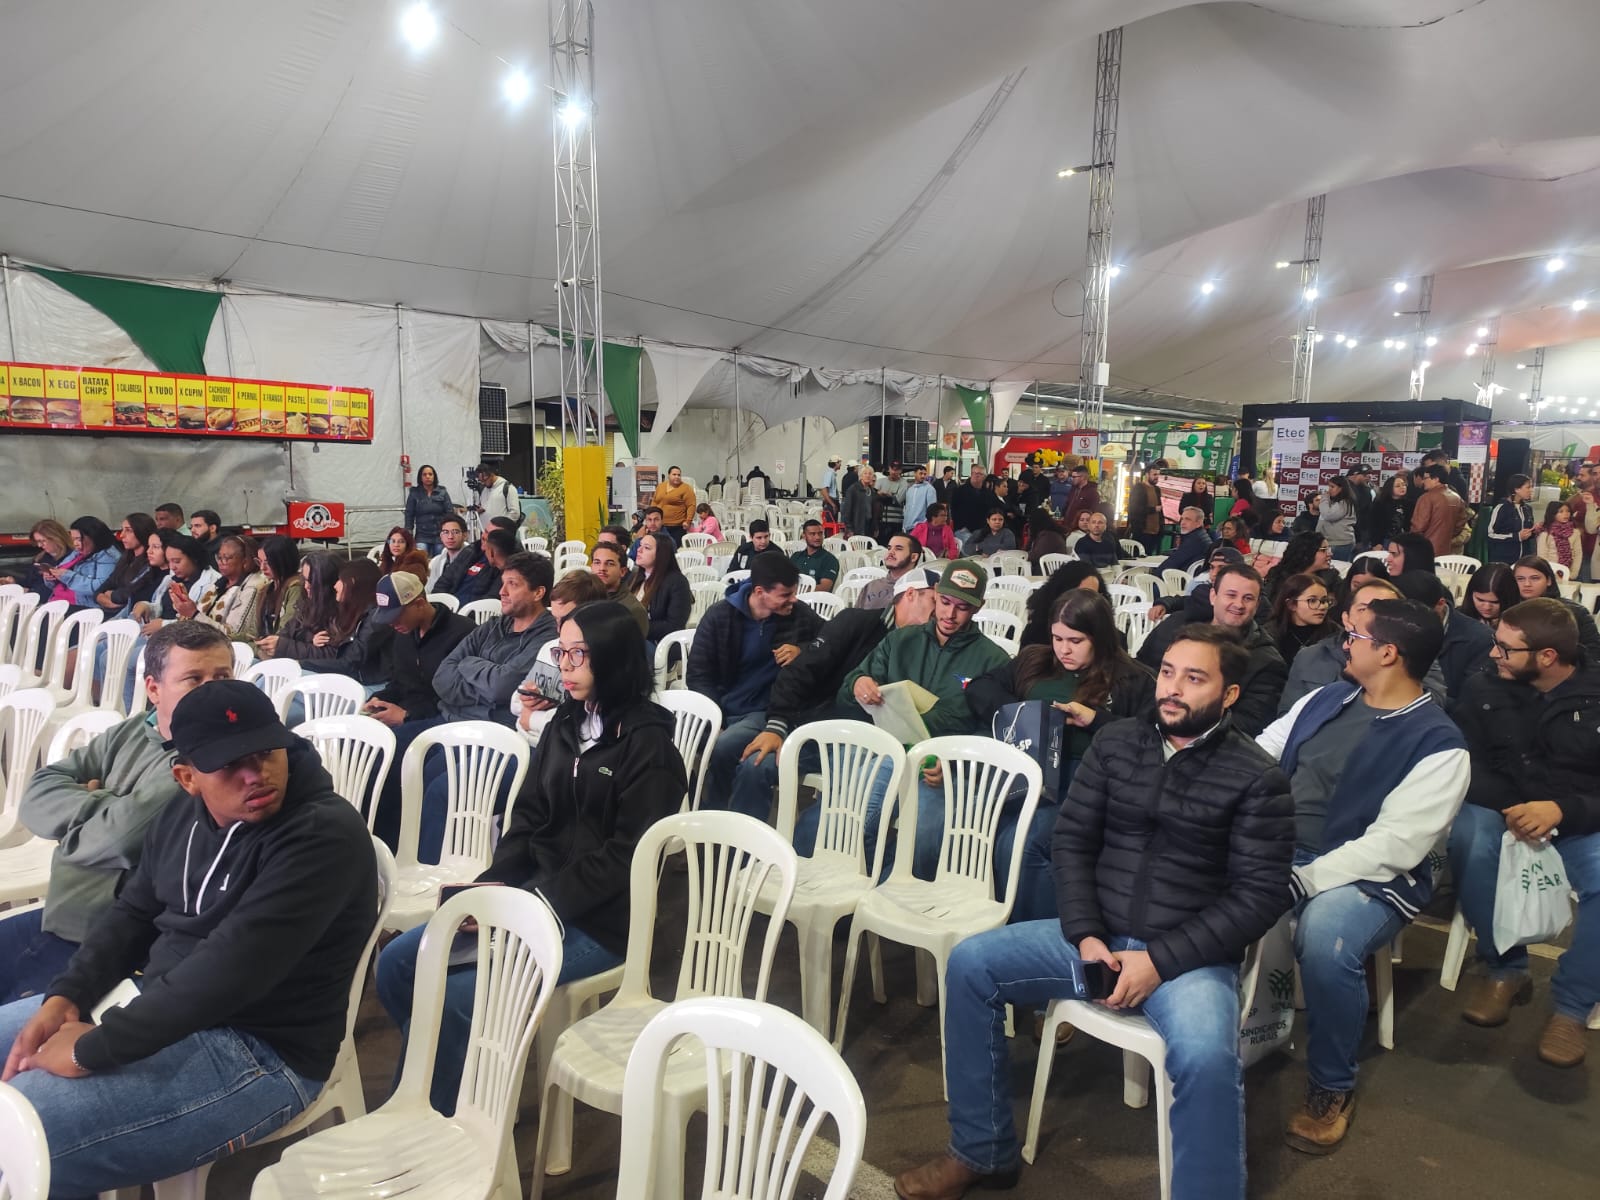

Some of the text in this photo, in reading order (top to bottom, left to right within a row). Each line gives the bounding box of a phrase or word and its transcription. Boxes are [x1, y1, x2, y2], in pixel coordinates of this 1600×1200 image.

[19, 377, 41, 388] BACON
[49, 380, 76, 389] X EGG
[82, 376, 109, 386] BATATA
[85, 386, 108, 395] CHIPS
[155, 386, 173, 396] TUDO
[288, 395, 306, 405] PASTEL
[1277, 427, 1305, 438] Etec
[1322, 455, 1339, 463] Etec
[1281, 487, 1298, 495] Etec
[1240, 1020, 1286, 1038] SINDICATOS
